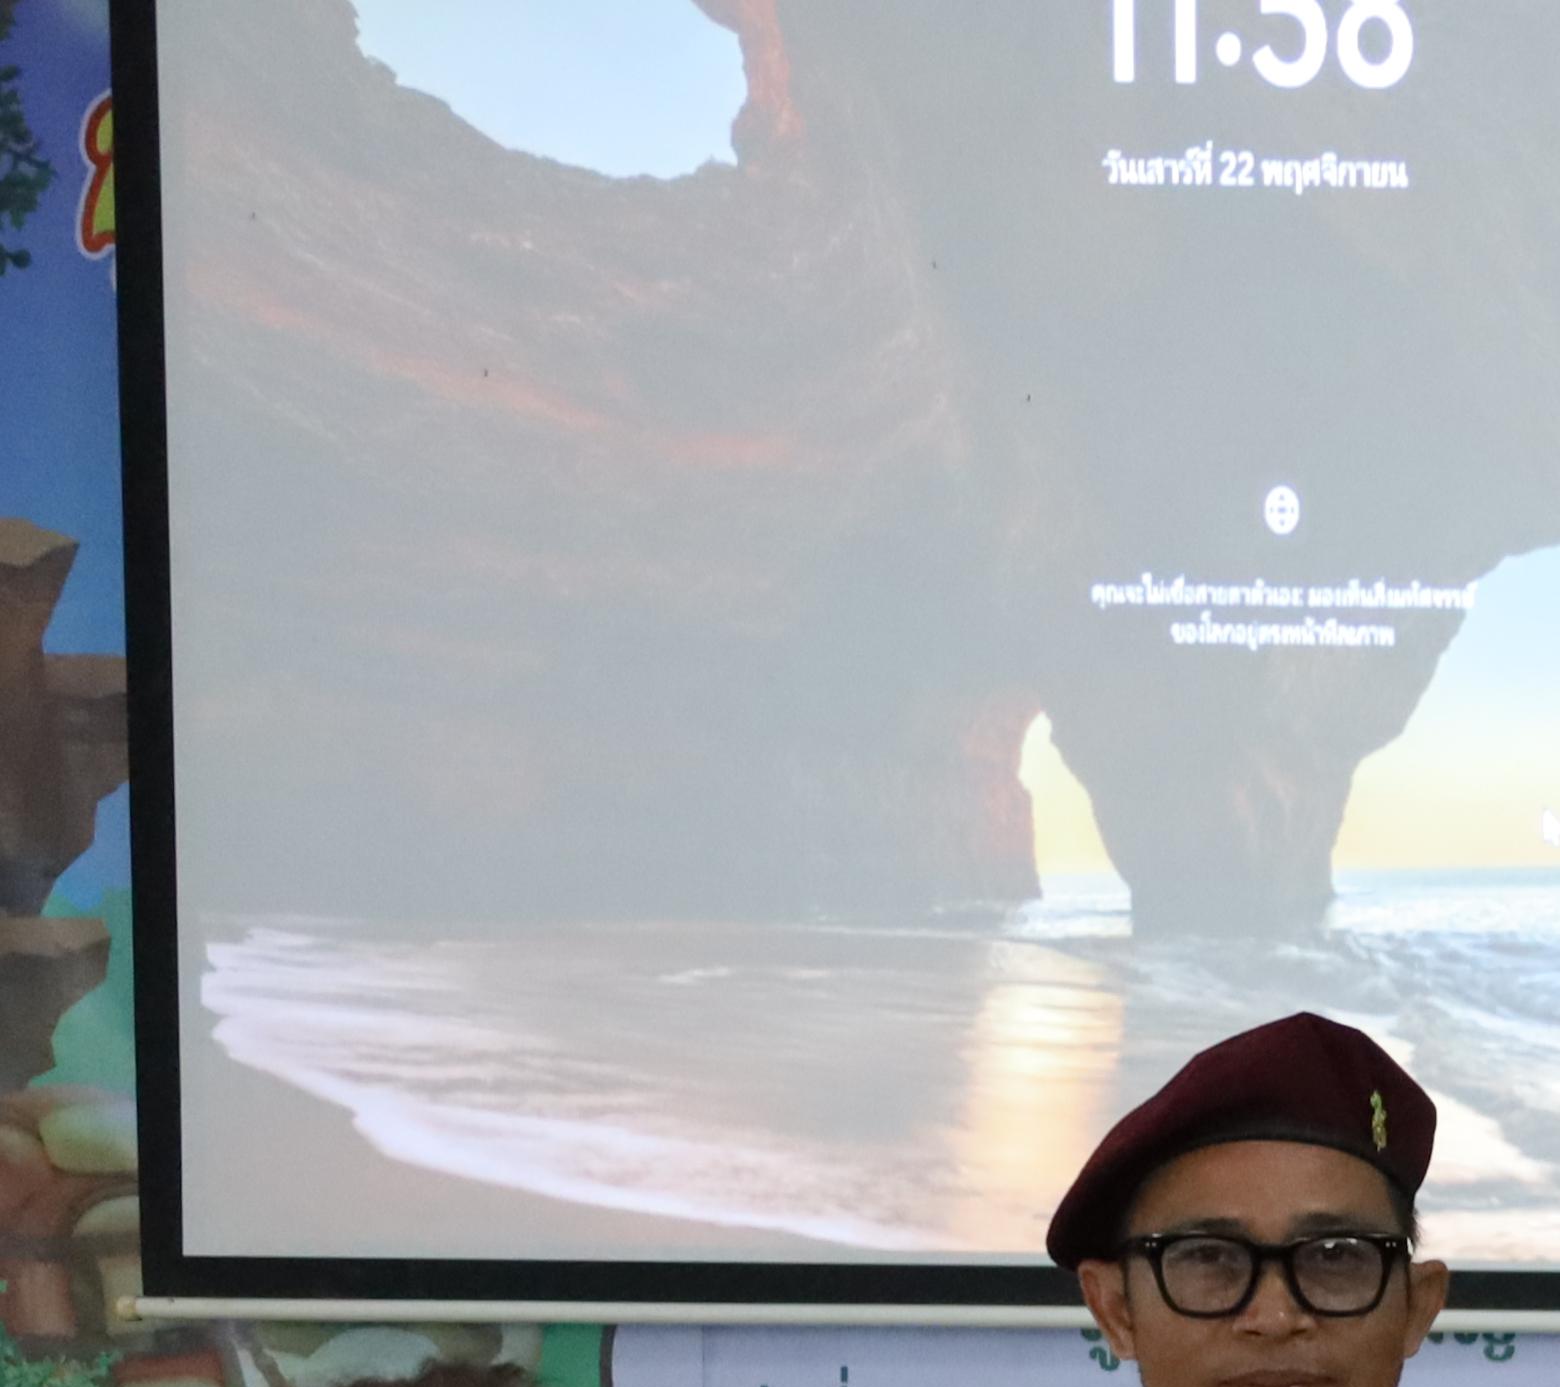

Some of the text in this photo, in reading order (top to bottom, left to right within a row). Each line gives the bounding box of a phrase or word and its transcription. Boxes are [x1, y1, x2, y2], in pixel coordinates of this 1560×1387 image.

[1101, 140, 1409, 194] วันเสาร์ที่ 22 พฤศจิกายน
